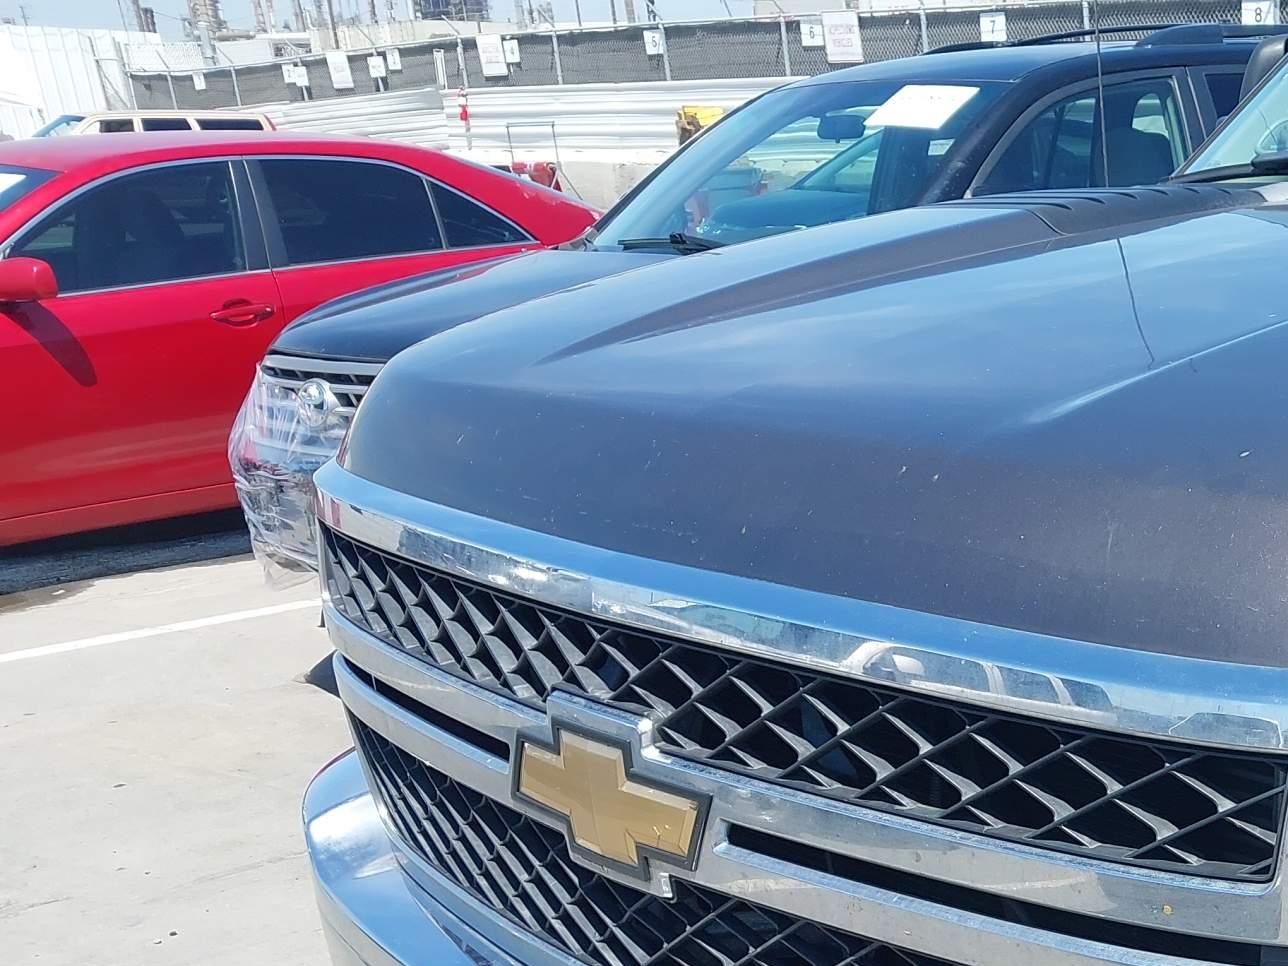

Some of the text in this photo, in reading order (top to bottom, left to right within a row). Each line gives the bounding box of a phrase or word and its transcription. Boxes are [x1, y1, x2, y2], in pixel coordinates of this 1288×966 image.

[1255, 6, 1263, 23] 8
[809, 25, 815, 39] 6
[990, 19, 996, 34] 7
